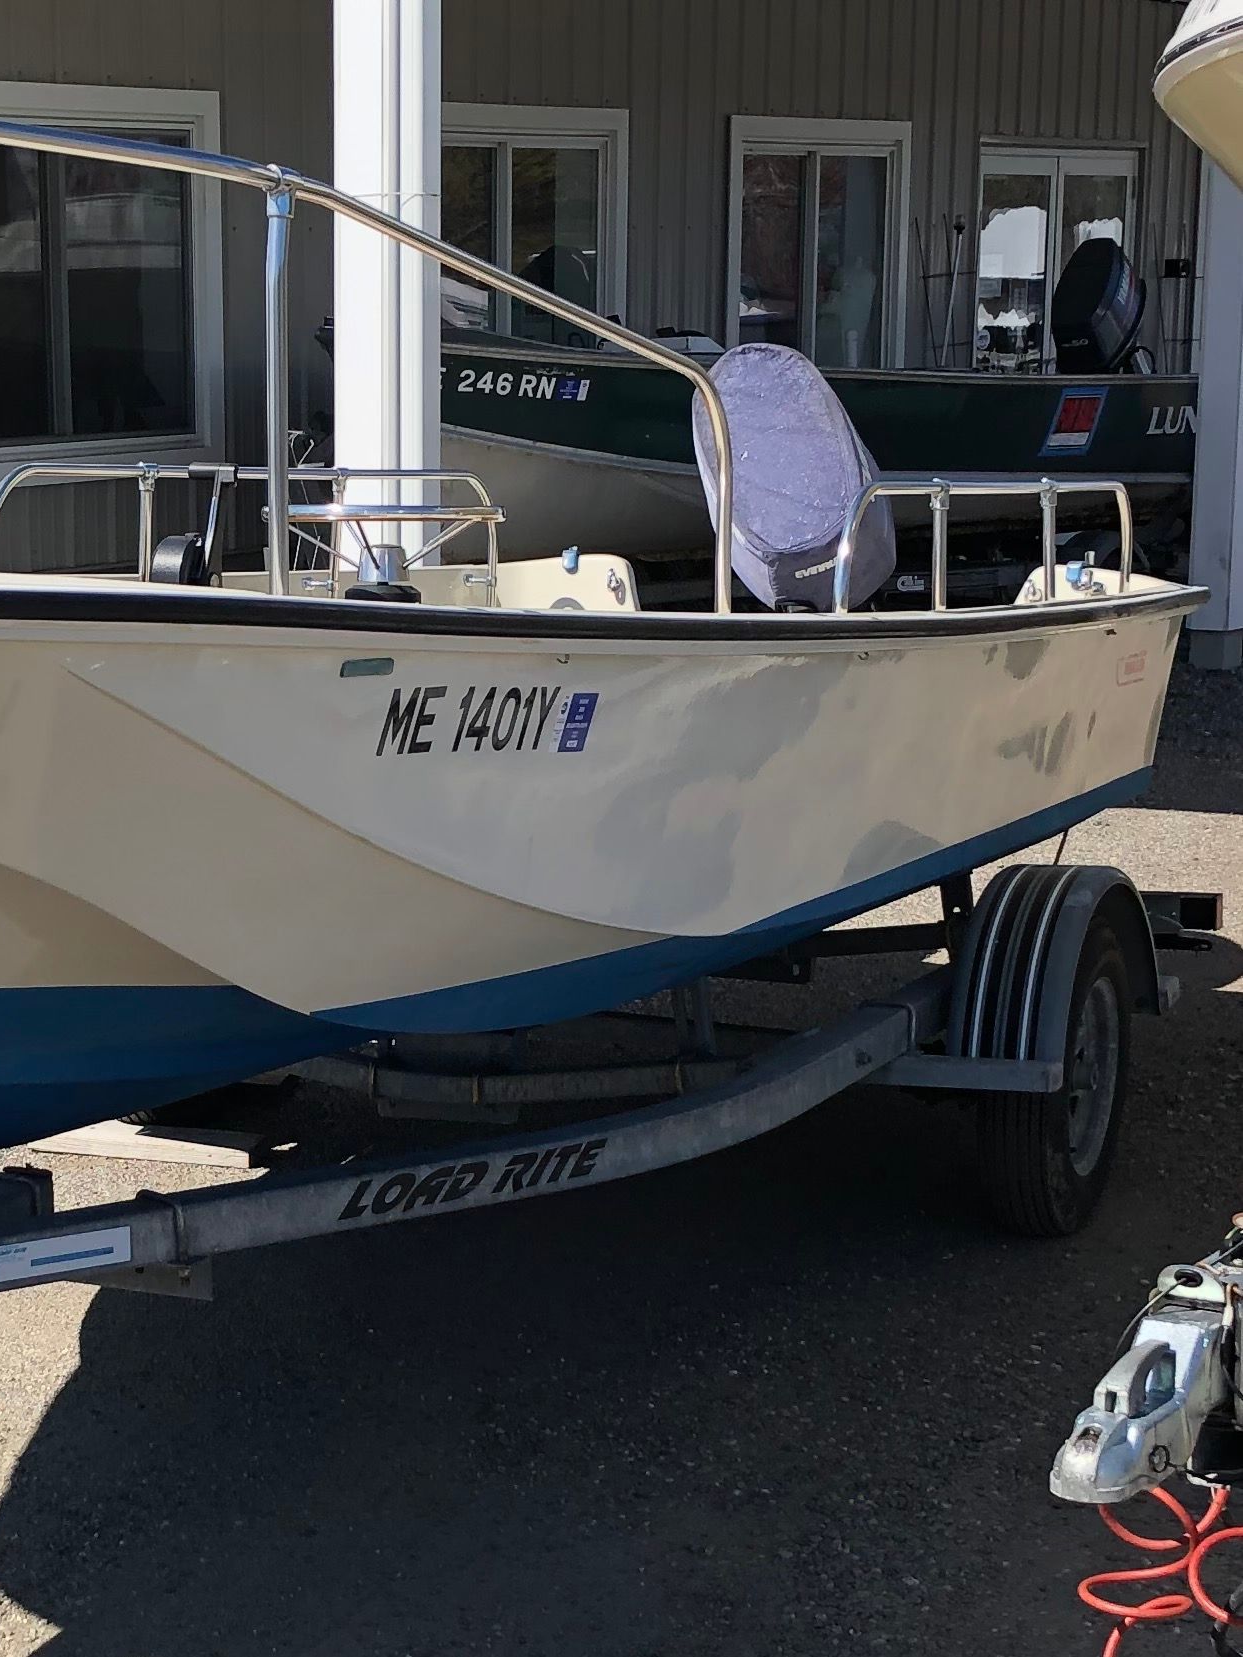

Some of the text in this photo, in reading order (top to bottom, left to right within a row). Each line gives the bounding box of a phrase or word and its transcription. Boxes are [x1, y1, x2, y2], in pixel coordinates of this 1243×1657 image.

[457, 369, 514, 396] 246
[518, 374, 557, 400] RN
[375, 685, 448, 757] ME
[451, 685, 562, 752] 1401Y
[337, 1137, 609, 1221] LOAD RITE
